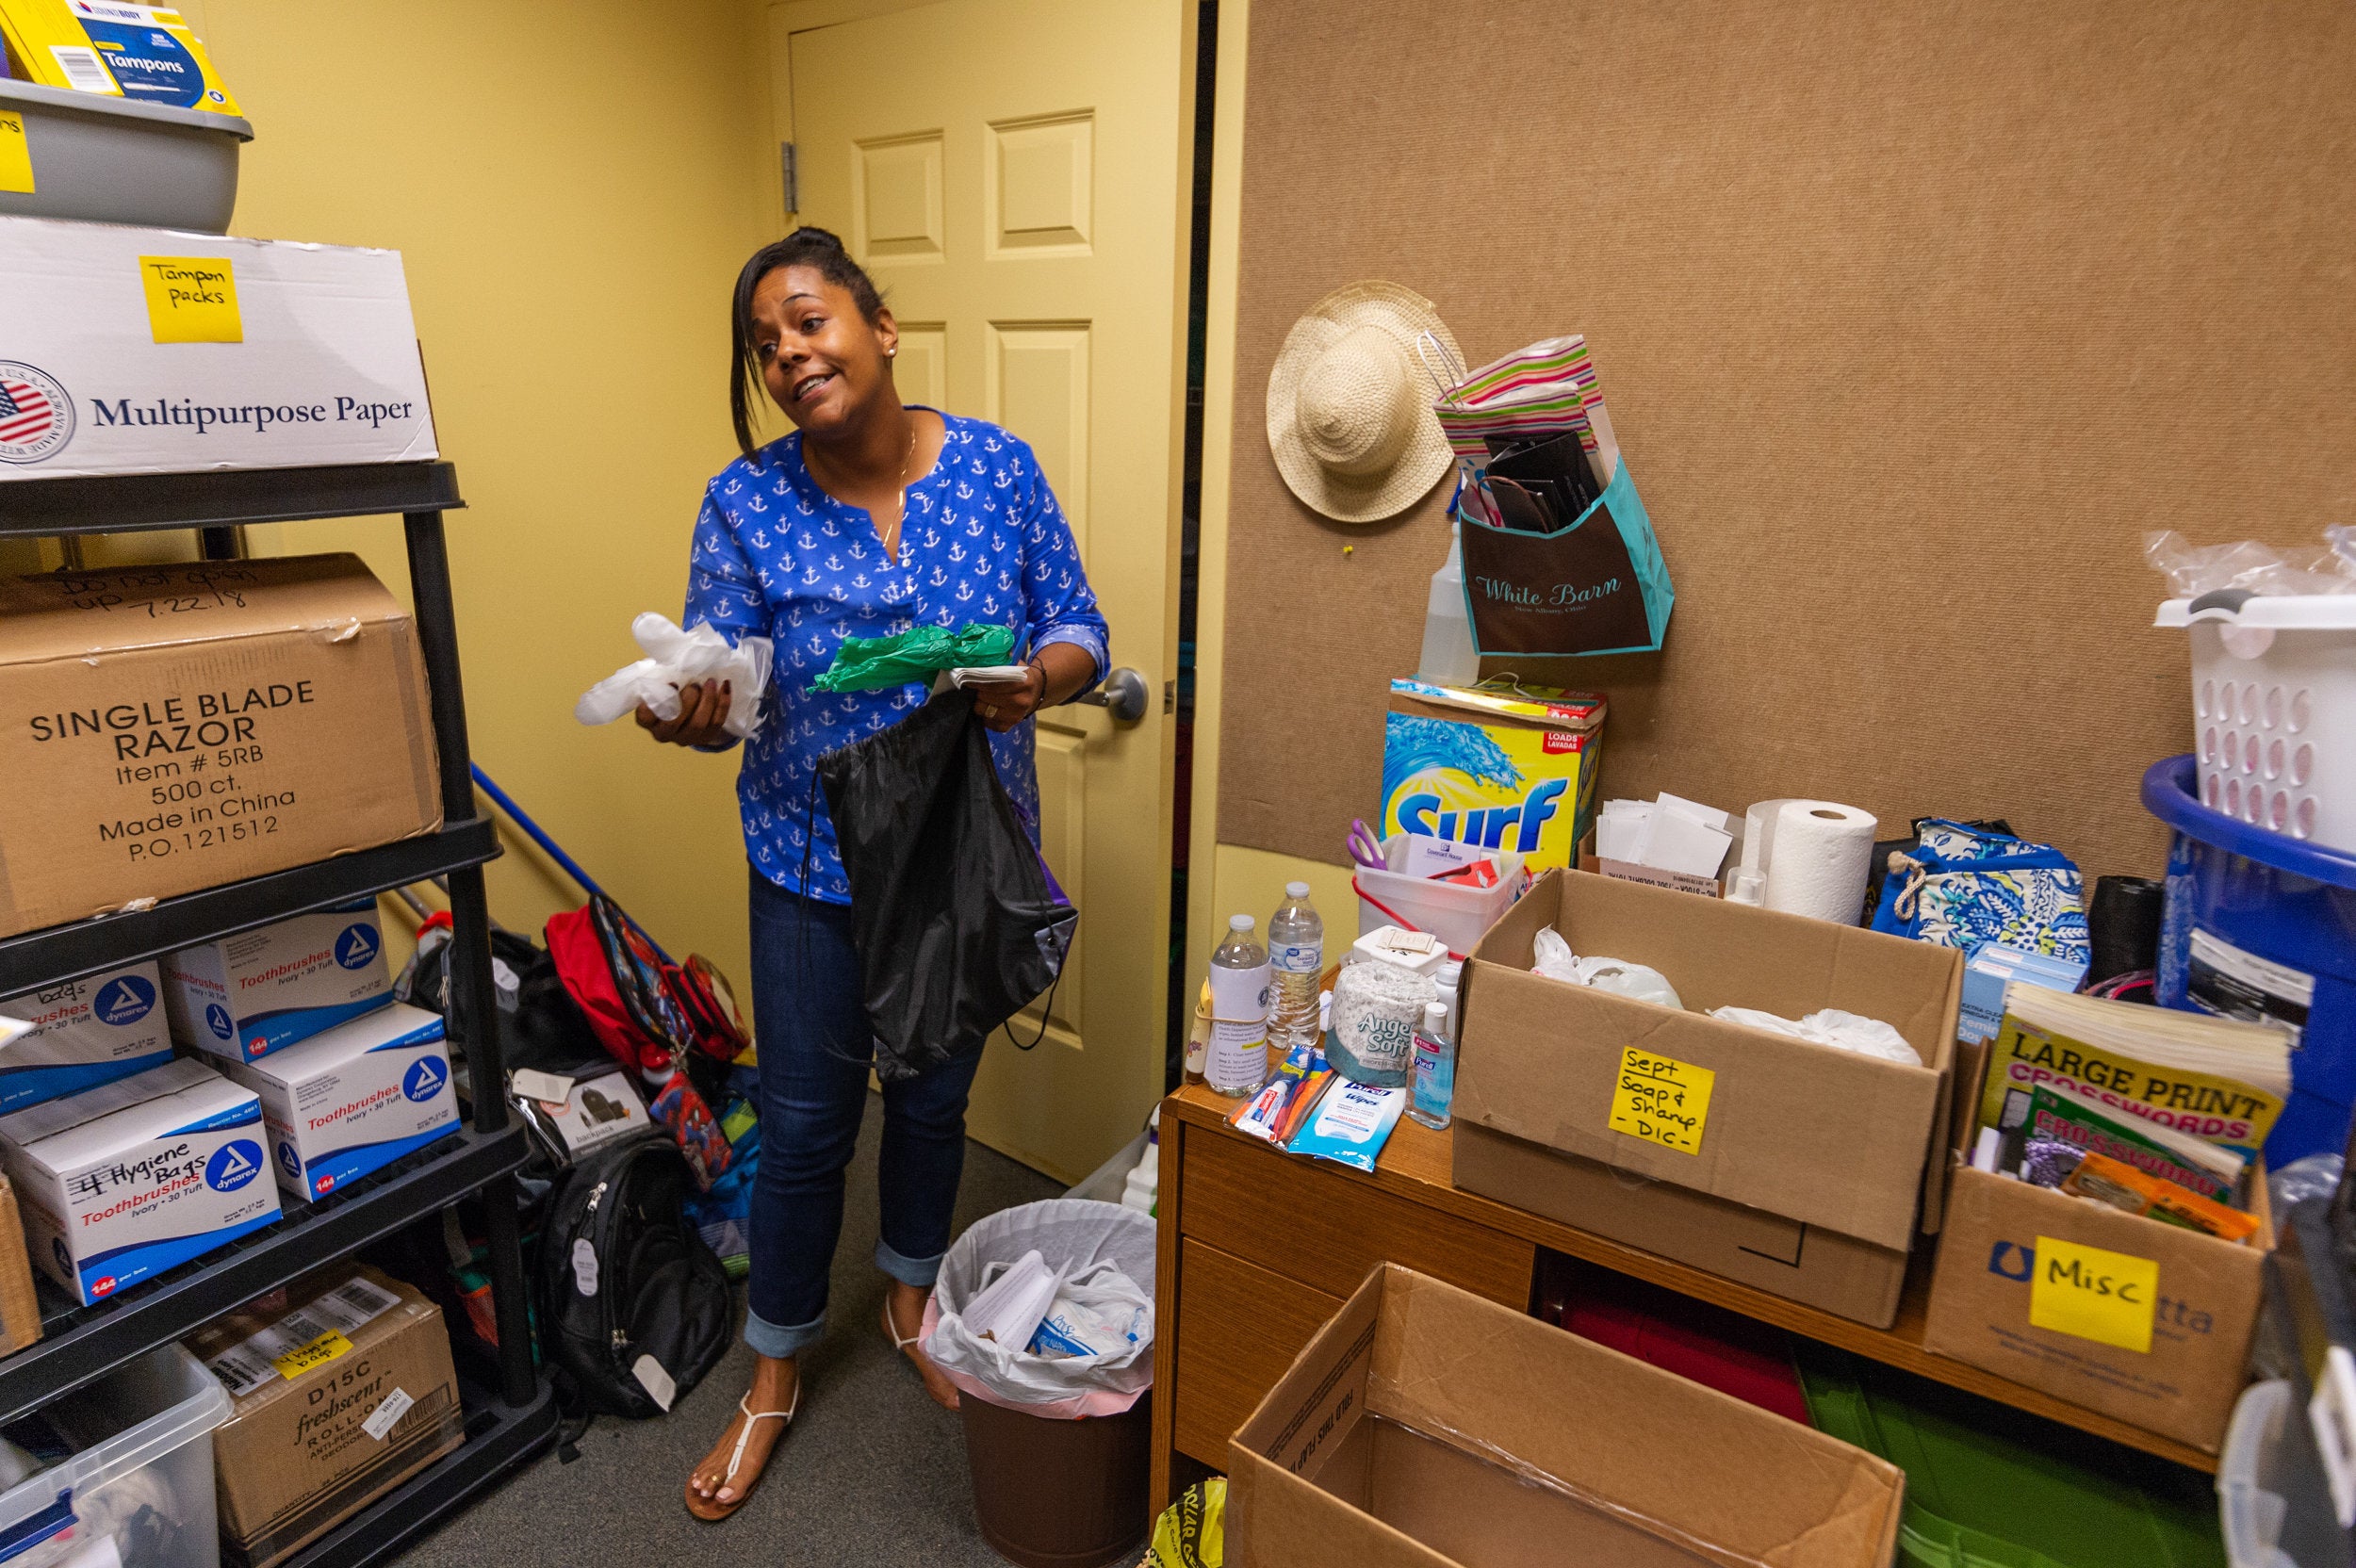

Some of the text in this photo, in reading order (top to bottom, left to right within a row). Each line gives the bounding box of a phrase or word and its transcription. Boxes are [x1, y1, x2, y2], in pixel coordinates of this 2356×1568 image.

[102, 52, 185, 74] Tampons
[149, 264, 225, 285] Tampon
[168, 286, 225, 308] packs
[90, 397, 413, 435] Multipurpose Paper
[1475, 576, 1622, 606] White Barn
[29, 680, 315, 742] SINGLE BLADE
[114, 716, 255, 761] RAZOR
[1547, 741, 1578, 750] LAVADAS
[1548, 733, 1578, 742] LOADS
[116, 744, 265, 785] Item # 5RB
[152, 775, 241, 805] 500 ct.
[99, 790, 296, 841] Made in China
[1397, 777, 1570, 853] Surf
[238, 949, 331, 989] Toothbrushes
[278, 959, 334, 986] Ivory 30 Tuft
[344, 950, 375, 967] dynarex
[31, 1003, 89, 1025] ushes
[56, 1021, 67, 1031] 30
[71, 1014, 91, 1025] Tuft
[106, 1005, 148, 1022] dynarex
[1960, 1015, 1999, 1035] Femin
[1962, 1003, 2004, 1018] EXTRA CLEA
[250, 1038, 267, 1053] 144
[1366, 1035, 1409, 1057] Soft
[1416, 1056, 1434, 1070] Purell
[1627, 1049, 1678, 1077] Sept
[2011, 1033, 2267, 1119] LARGE PRINT
[412, 1080, 443, 1101] dynarex
[1346, 1093, 1380, 1106] Wipes
[1621, 1075, 1670, 1106] Soap
[308, 1084, 400, 1131] Toothbrushes
[346, 1094, 401, 1124] Ivory 30 Tuft
[264, 1115, 294, 1132] brushes
[576, 1125, 614, 1143] backpack
[109, 1142, 190, 1185] Hygiene
[2036, 1109, 2217, 1195] CROSSWORD
[154, 1154, 206, 1185] Bags
[216, 1167, 258, 1189] dynarex
[317, 1176, 335, 1192] 144
[81, 1172, 200, 1226] Toothbrushes
[132, 1183, 203, 1218] Ivory 30 Tuft
[91, 1277, 116, 1295] 144
[2048, 1258, 2141, 1304] Misc
[2158, 1296, 2213, 1334] tta
[307, 1361, 370, 1406] D15C
[294, 1376, 382, 1446] freshscent
[1335, 1388, 1353, 1421] FOLD
[1317, 1413, 1334, 1444] THIS
[1298, 1436, 1317, 1470] FLAP
